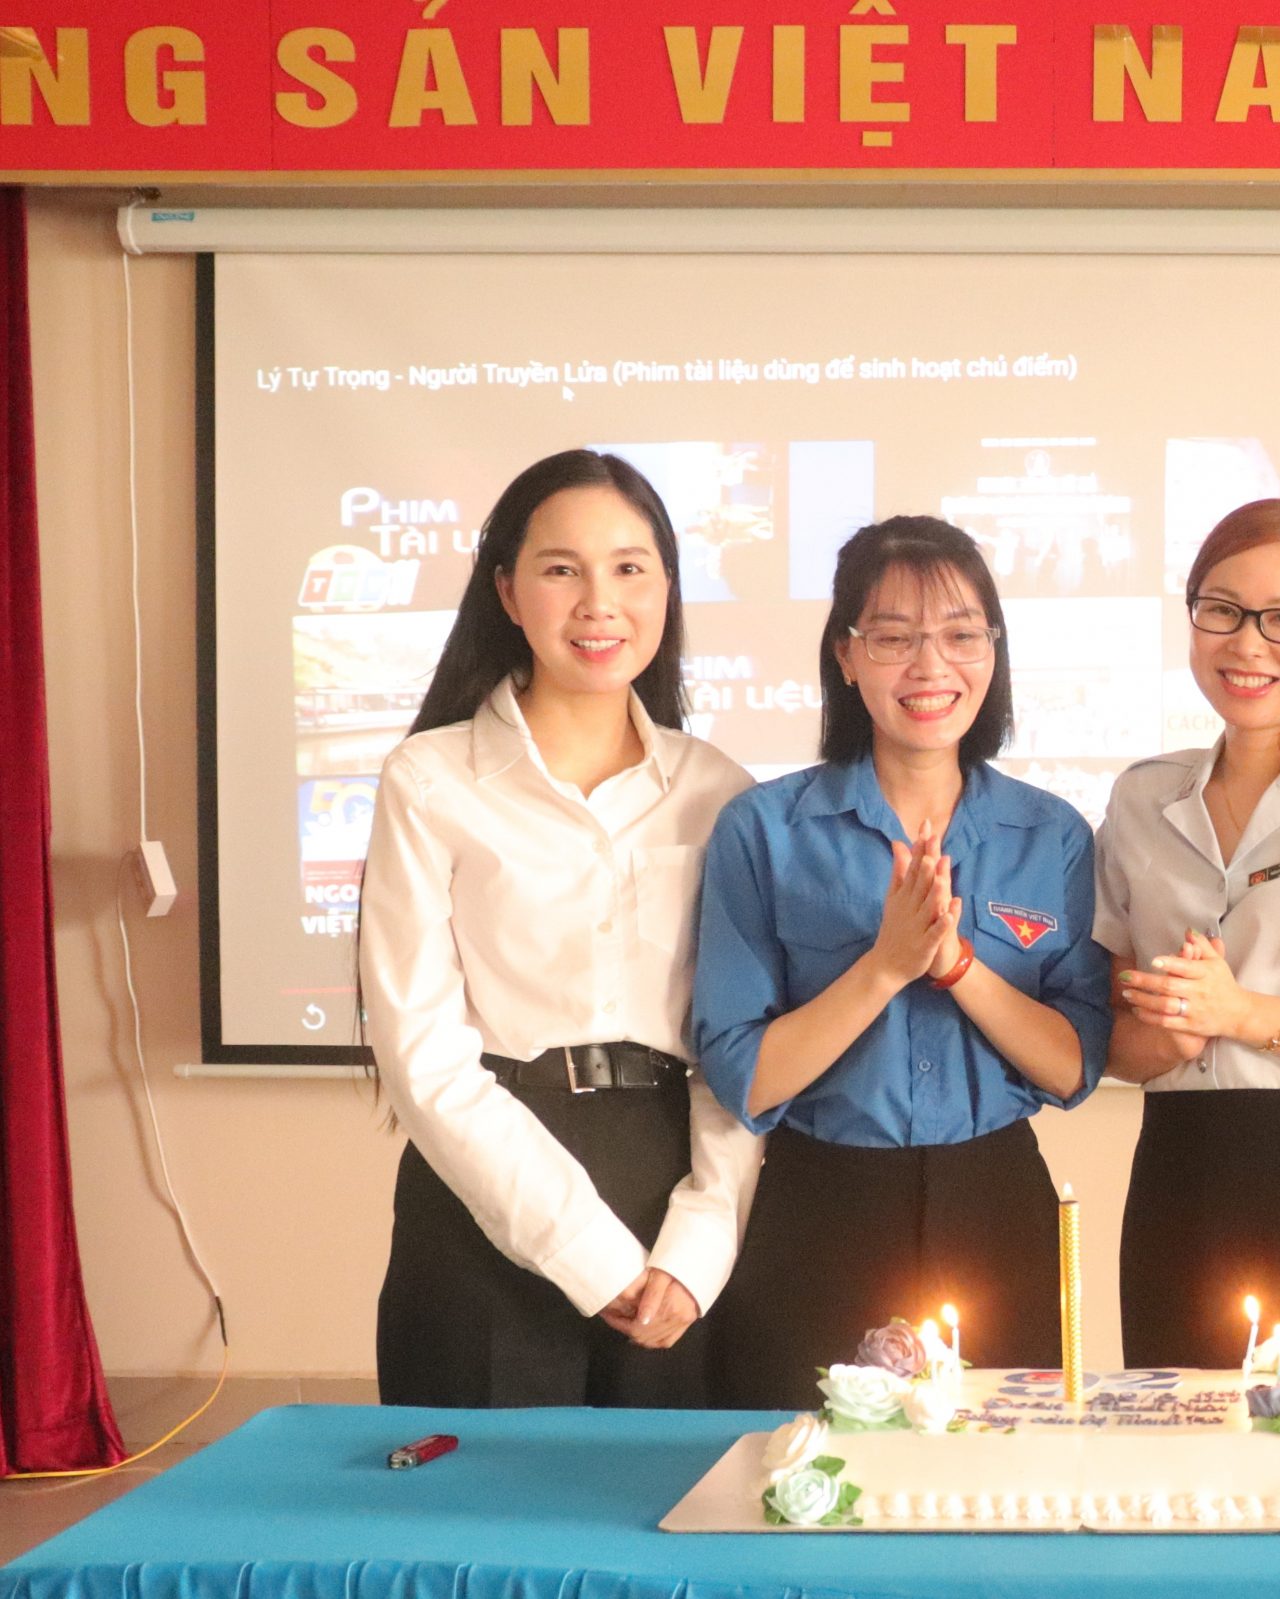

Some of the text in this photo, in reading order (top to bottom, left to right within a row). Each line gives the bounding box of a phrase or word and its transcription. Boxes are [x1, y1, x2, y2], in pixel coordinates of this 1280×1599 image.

[663, 0, 1018, 147] VIỆT
[256, 366, 282, 393] Lý
[286, 367, 319, 392] Tự
[323, 366, 390, 391] Trọng
[408, 362, 478, 390] Người
[482, 360, 558, 388] Truyền
[563, 360, 607, 383] Lửa
[613, 359, 679, 387] (Phim
[684, 359, 713, 381] tài
[718, 357, 758, 384] liệu
[763, 357, 820, 384] dùng
[825, 354, 855, 380] để
[859, 357, 906, 379] sinh
[911, 357, 962, 382] hoạt
[966, 354, 1008, 378] chủ
[1012, 352, 1078, 381] điểm)
